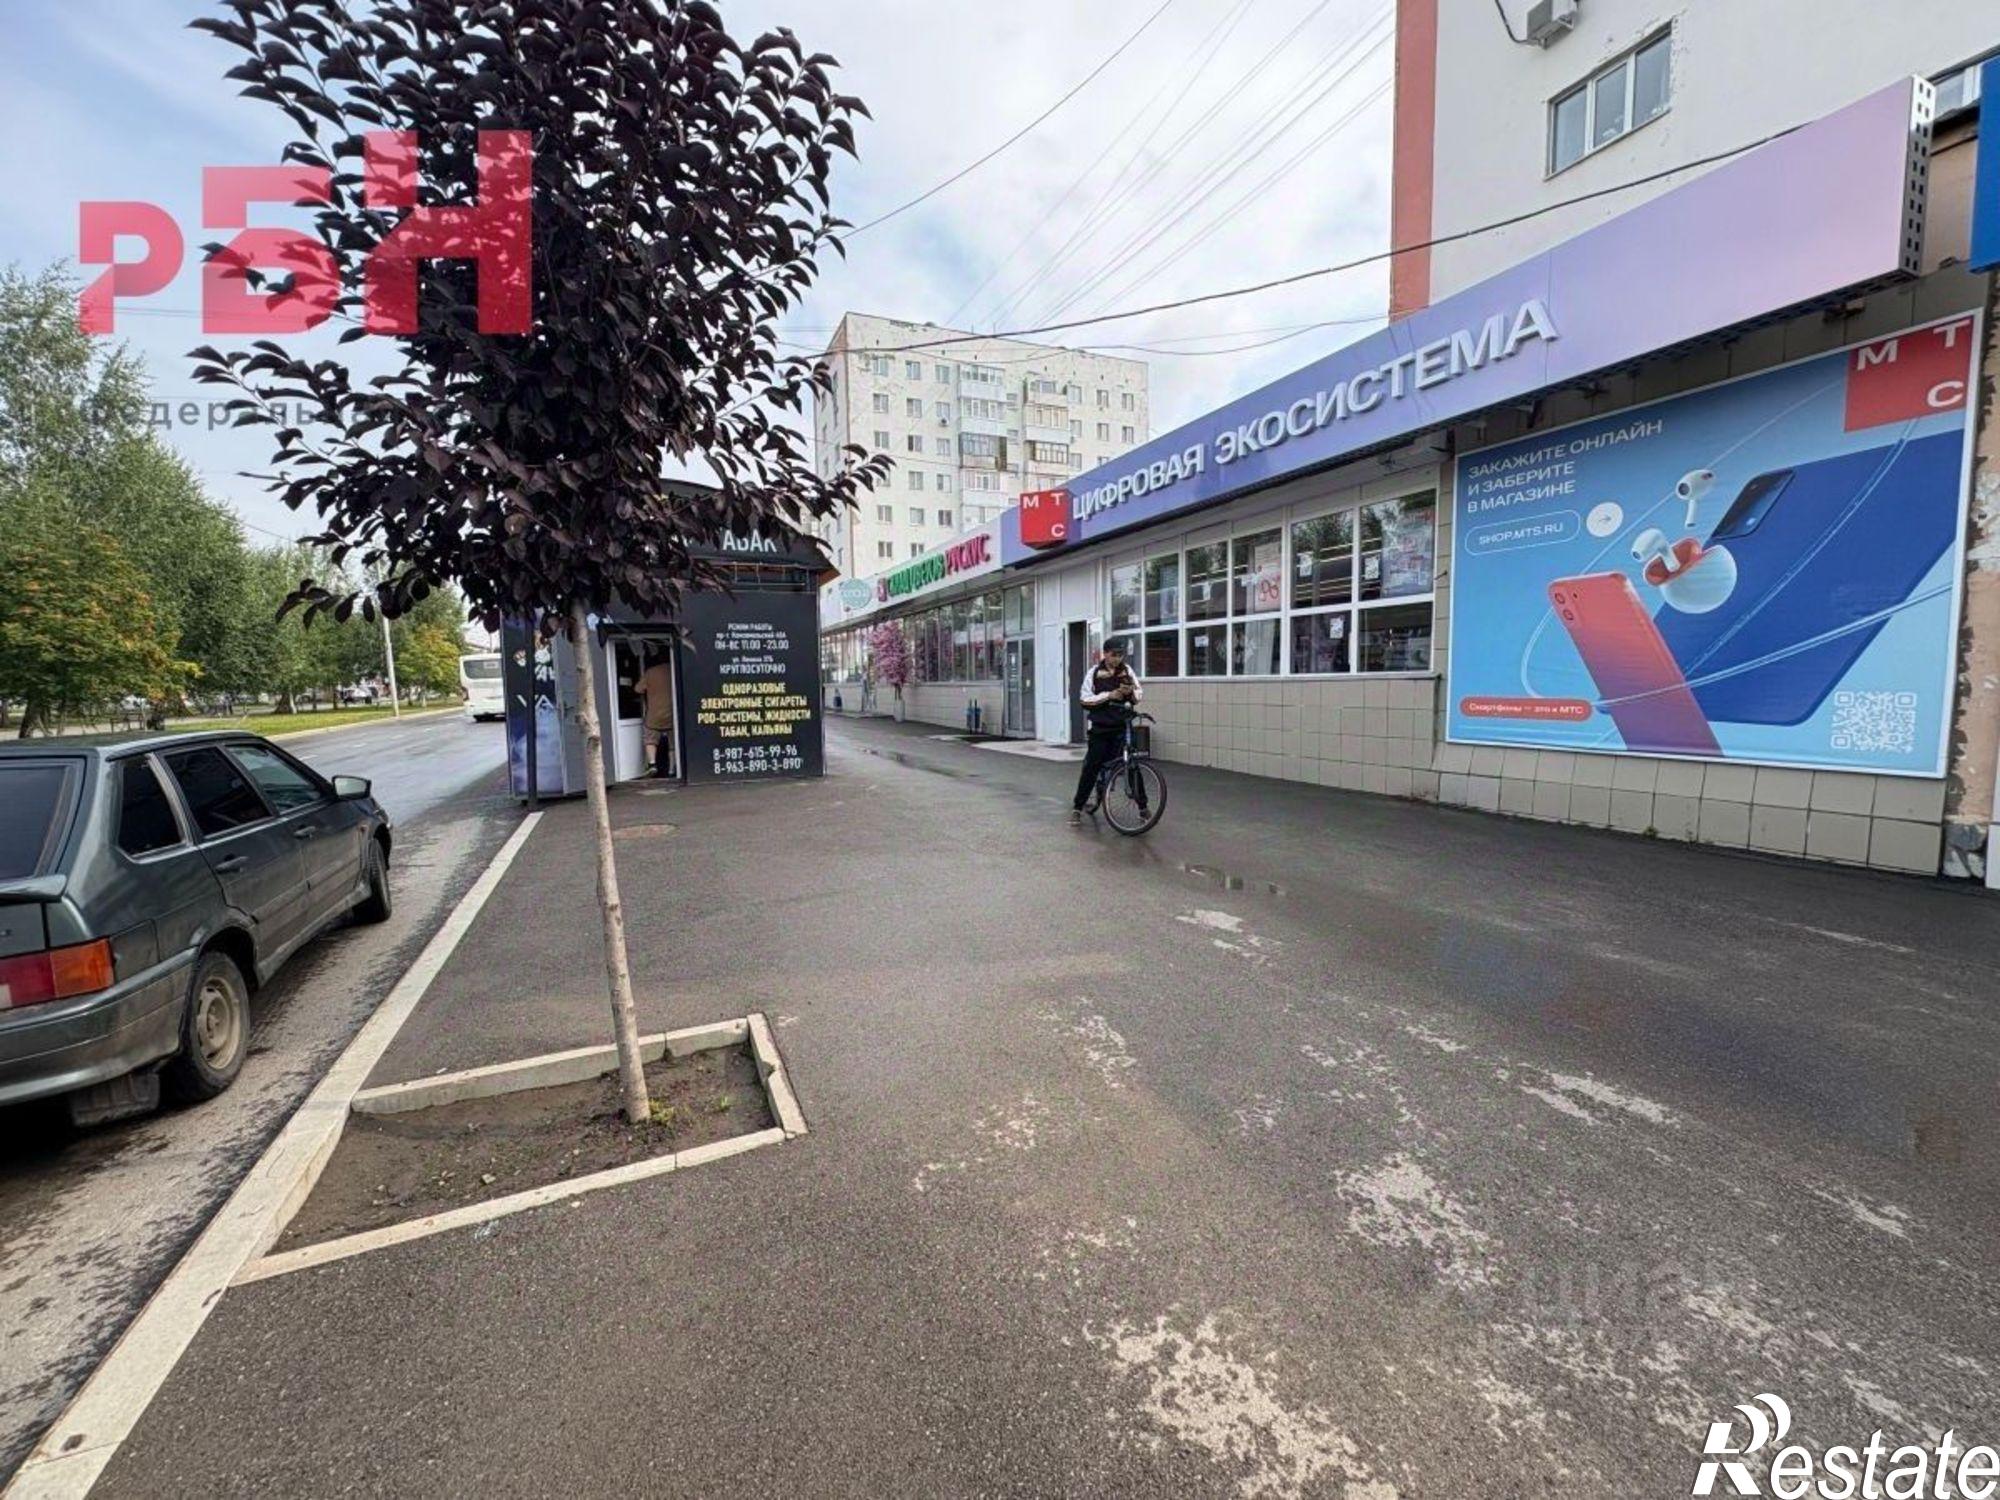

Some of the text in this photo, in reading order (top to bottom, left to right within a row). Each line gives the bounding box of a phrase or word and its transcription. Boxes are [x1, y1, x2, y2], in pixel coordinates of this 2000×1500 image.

[1073, 298, 1559, 520] ЦИФРОВАЯ ЭКОСИСТЕМА
[1469, 419, 1663, 479] ЗАКАЖИТЕ ОНЛАЙН
[1468, 461, 1575, 496] И ЗАБЕРИТЕ
[1468, 480, 1576, 513] В МАГАЗИНЕ
[1479, 522, 1563, 545] SHOP.MTS.RU
[719, 663, 786, 674] КРУГЛОСУТОЧНО
[722, 682, 786, 695] ОДНОРАЗОВЫЕ
[701, 695, 807, 709] ЭЛЕКТРОННЫЕ СИГАРЕТЫ
[765, 709, 811, 722] ЖИДКОСТИ
[1559, 705, 1583, 714] МТС
[751, 723, 792, 735] КАЛЬЯНЫ
